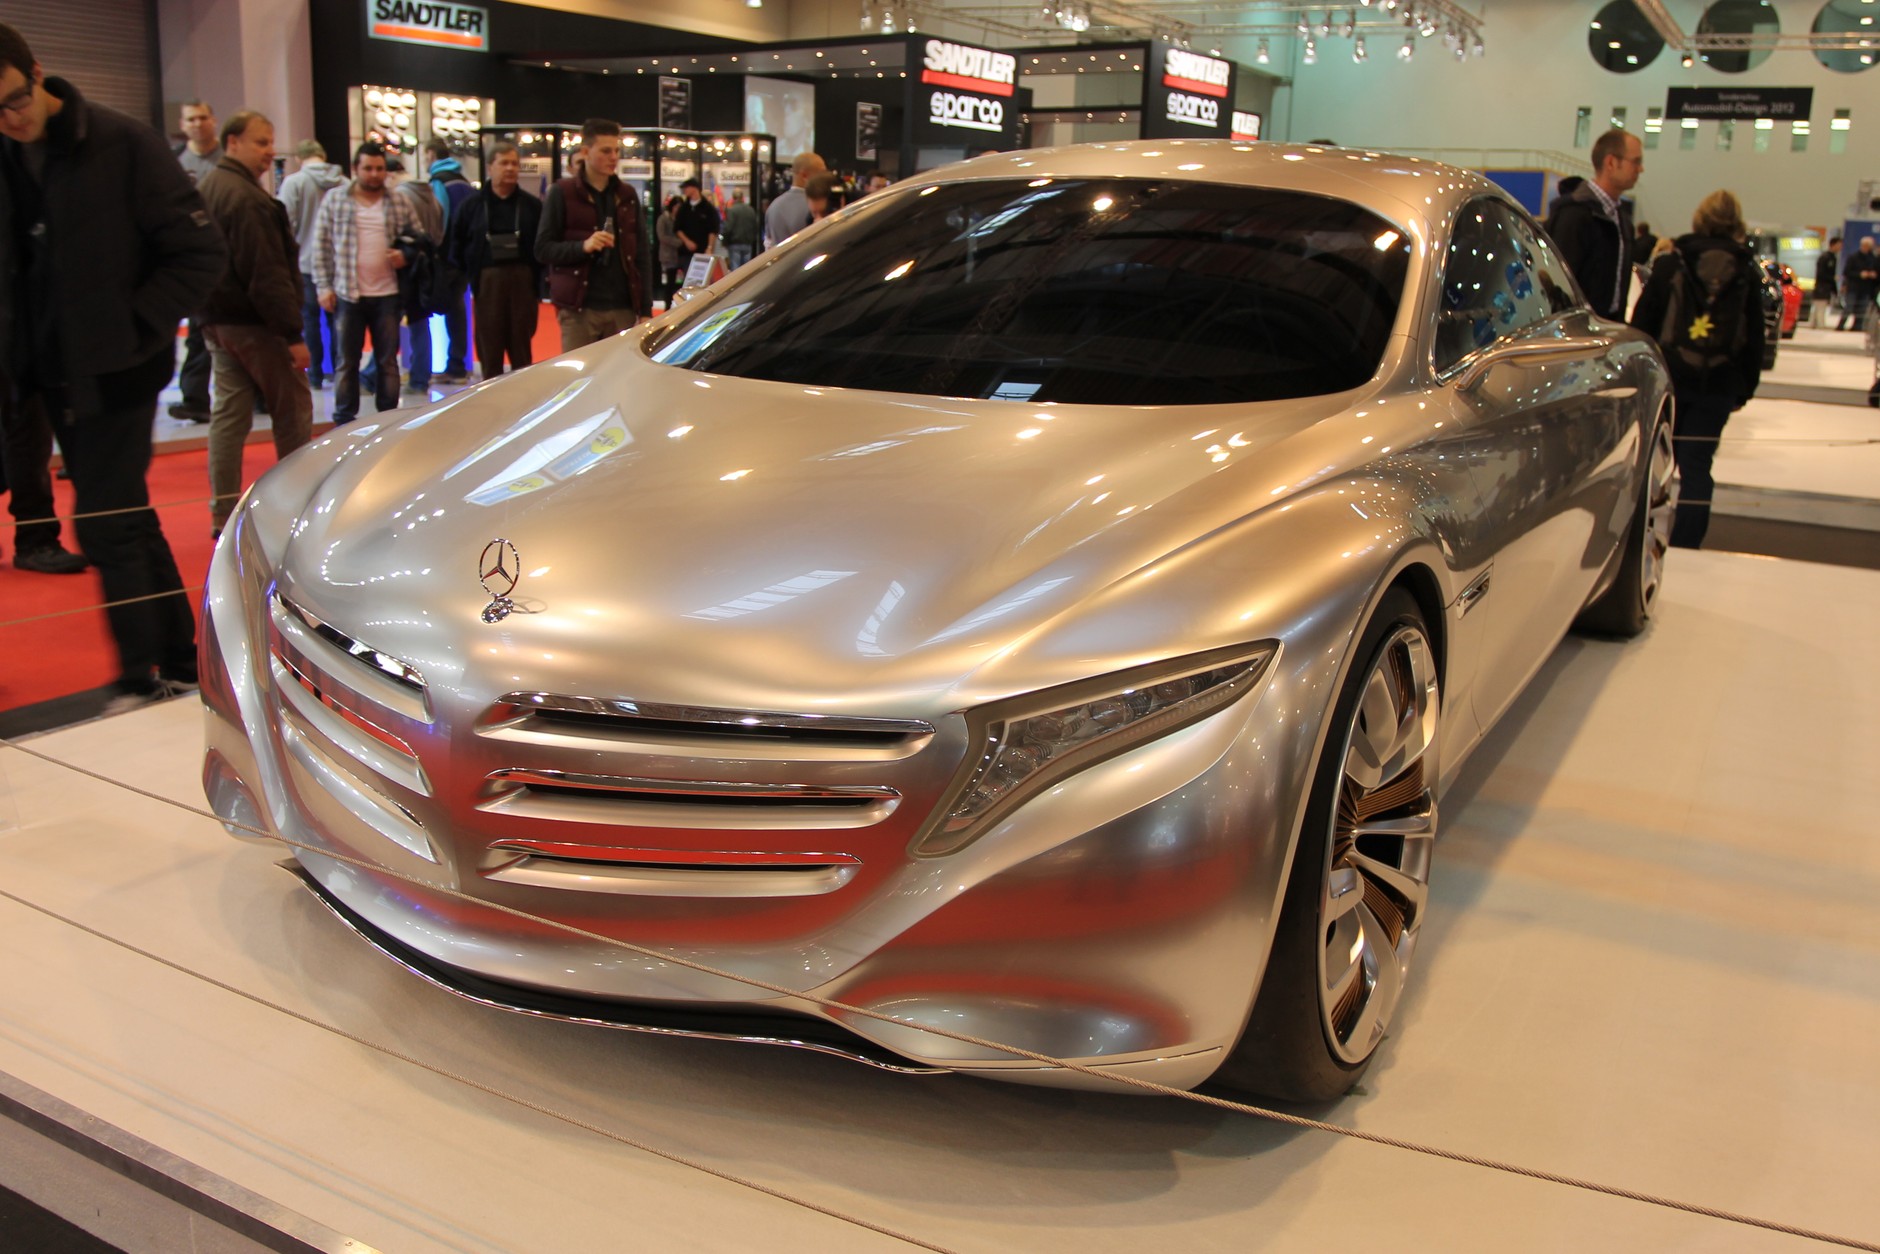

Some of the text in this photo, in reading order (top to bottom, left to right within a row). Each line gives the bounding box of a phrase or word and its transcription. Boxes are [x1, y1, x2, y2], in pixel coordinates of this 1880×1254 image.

[375, 0, 482, 33] SANDTLER
[924, 40, 1016, 85] SANDTLER
[1165, 49, 1230, 87] SANDTLER
[930, 91, 1003, 127] sparco
[1166, 92, 1218, 123] sparco
[1771, 102, 1795, 113] 2012
